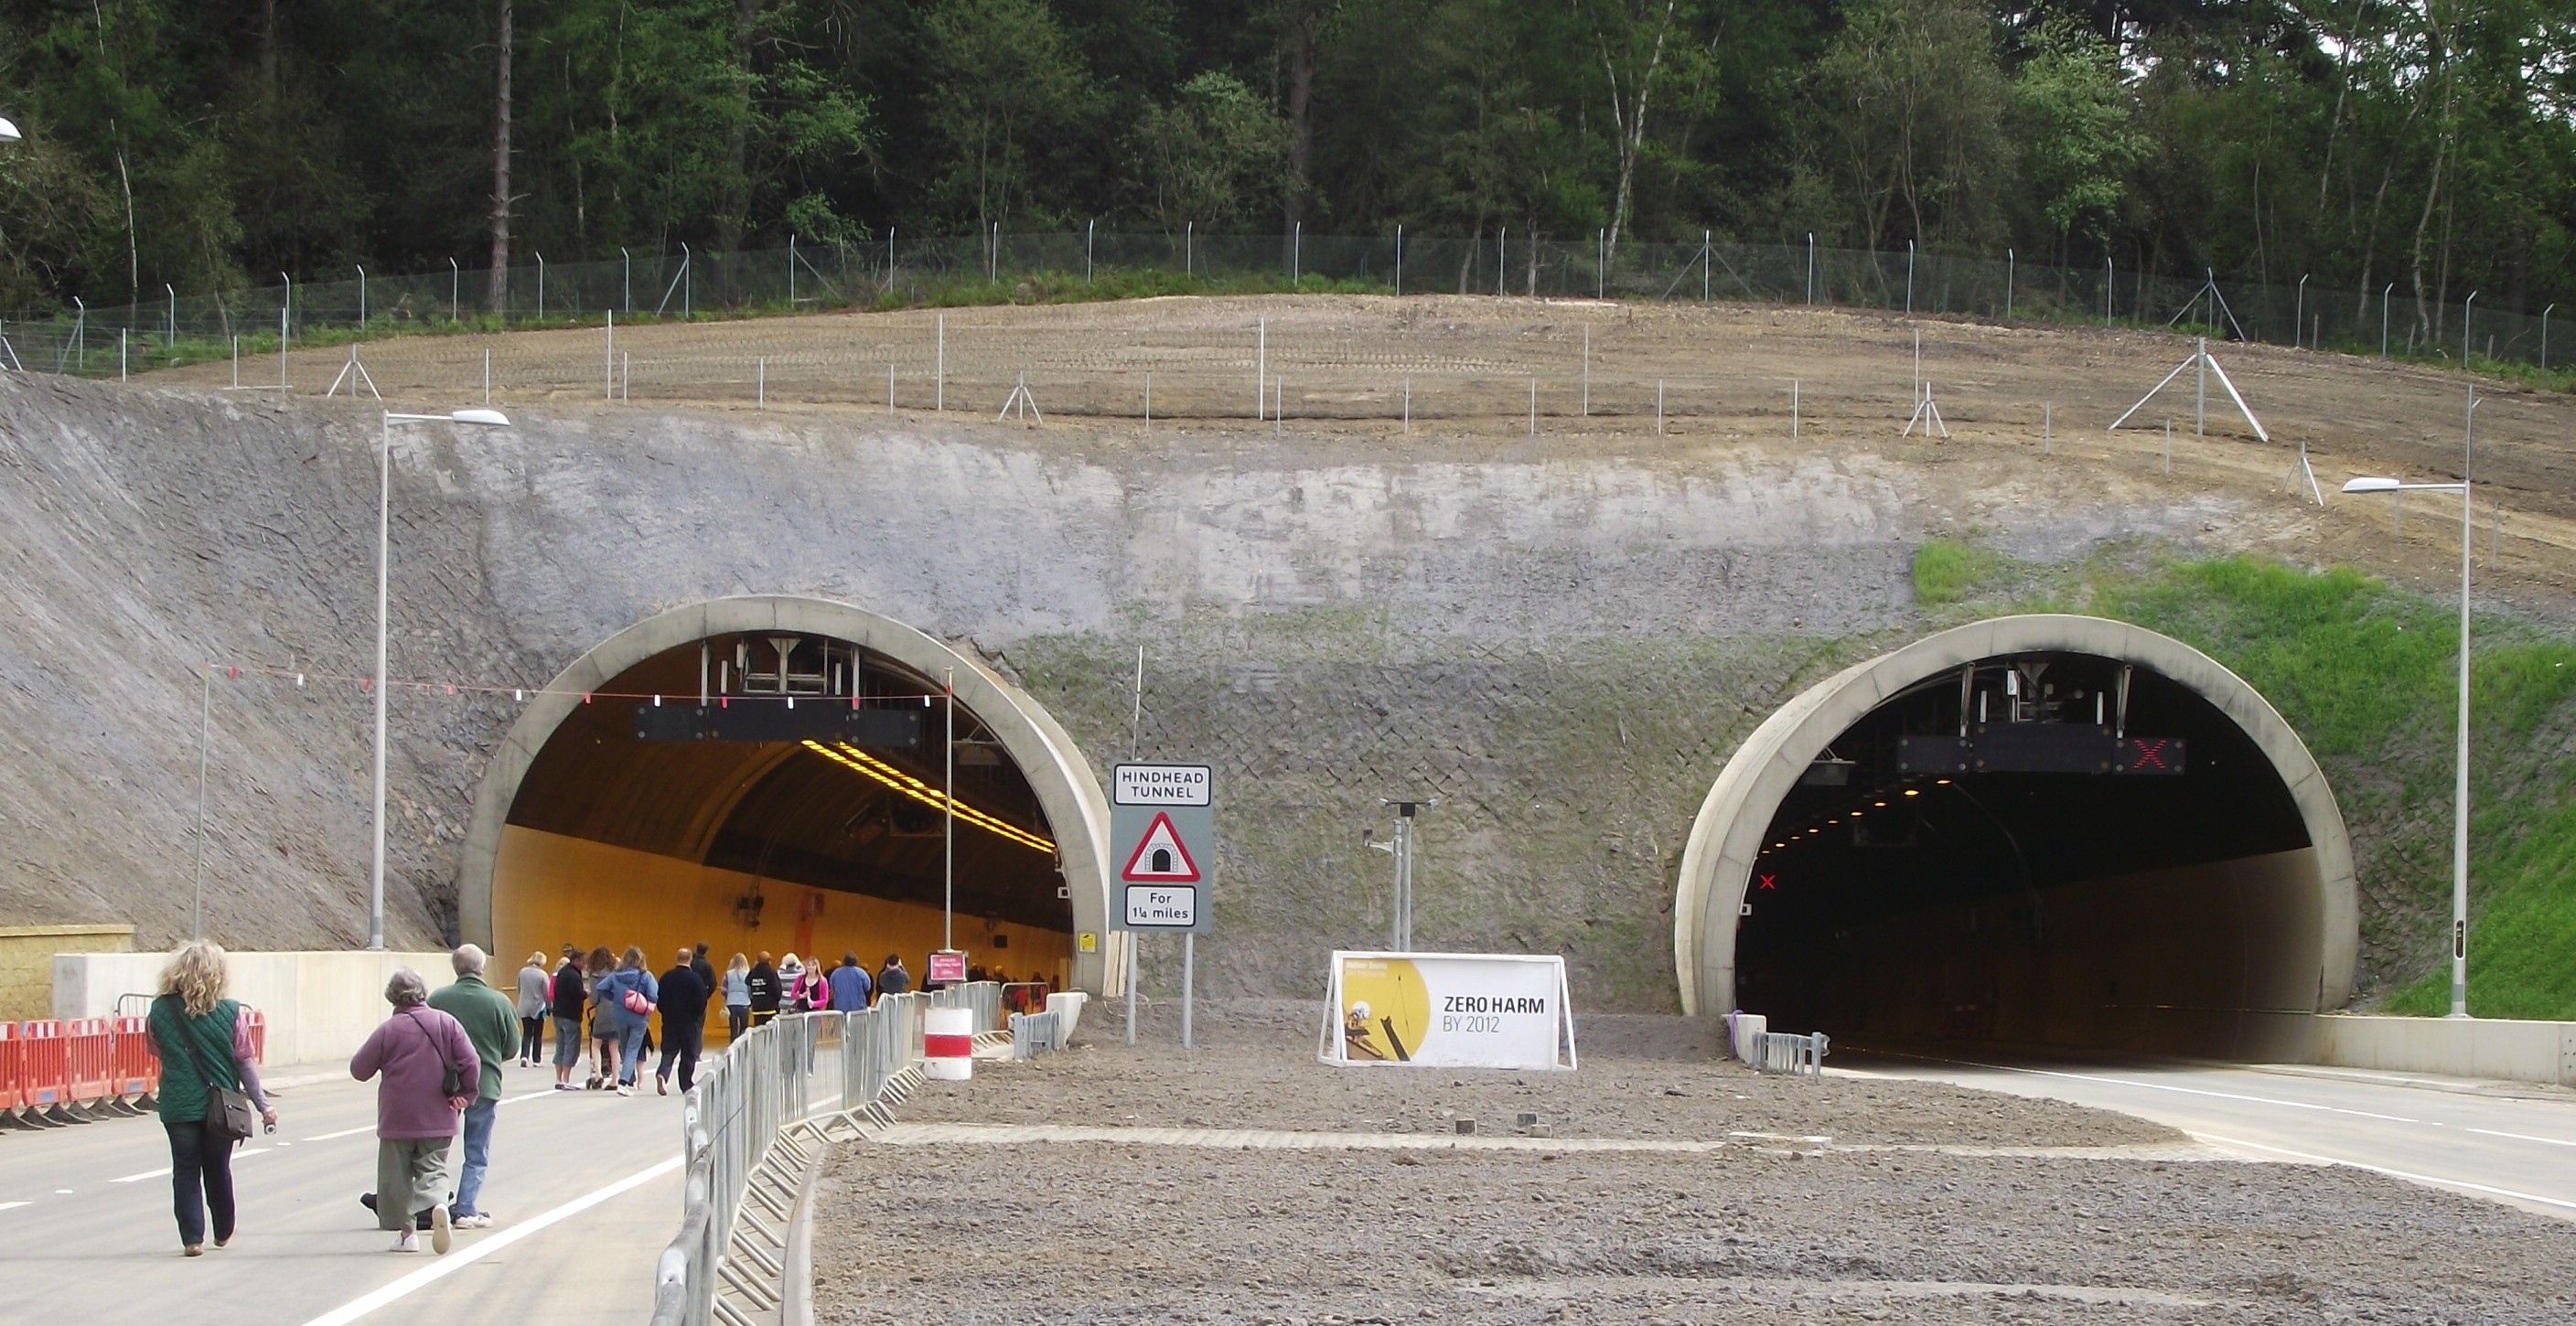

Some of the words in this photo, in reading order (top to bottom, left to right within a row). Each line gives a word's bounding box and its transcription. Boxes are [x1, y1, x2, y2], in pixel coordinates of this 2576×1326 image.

[1122, 771, 1204, 784] HINDHEAD
[1131, 786, 1194, 798] TUNNEL
[1150, 893, 1172, 904] For
[1153, 907, 1188, 919] miles
[1444, 996, 1487, 1013] ZERO
[1492, 997, 1545, 1014] HARM
[1443, 1015, 1462, 1032] BY
[1466, 1015, 1499, 1033] 2012
